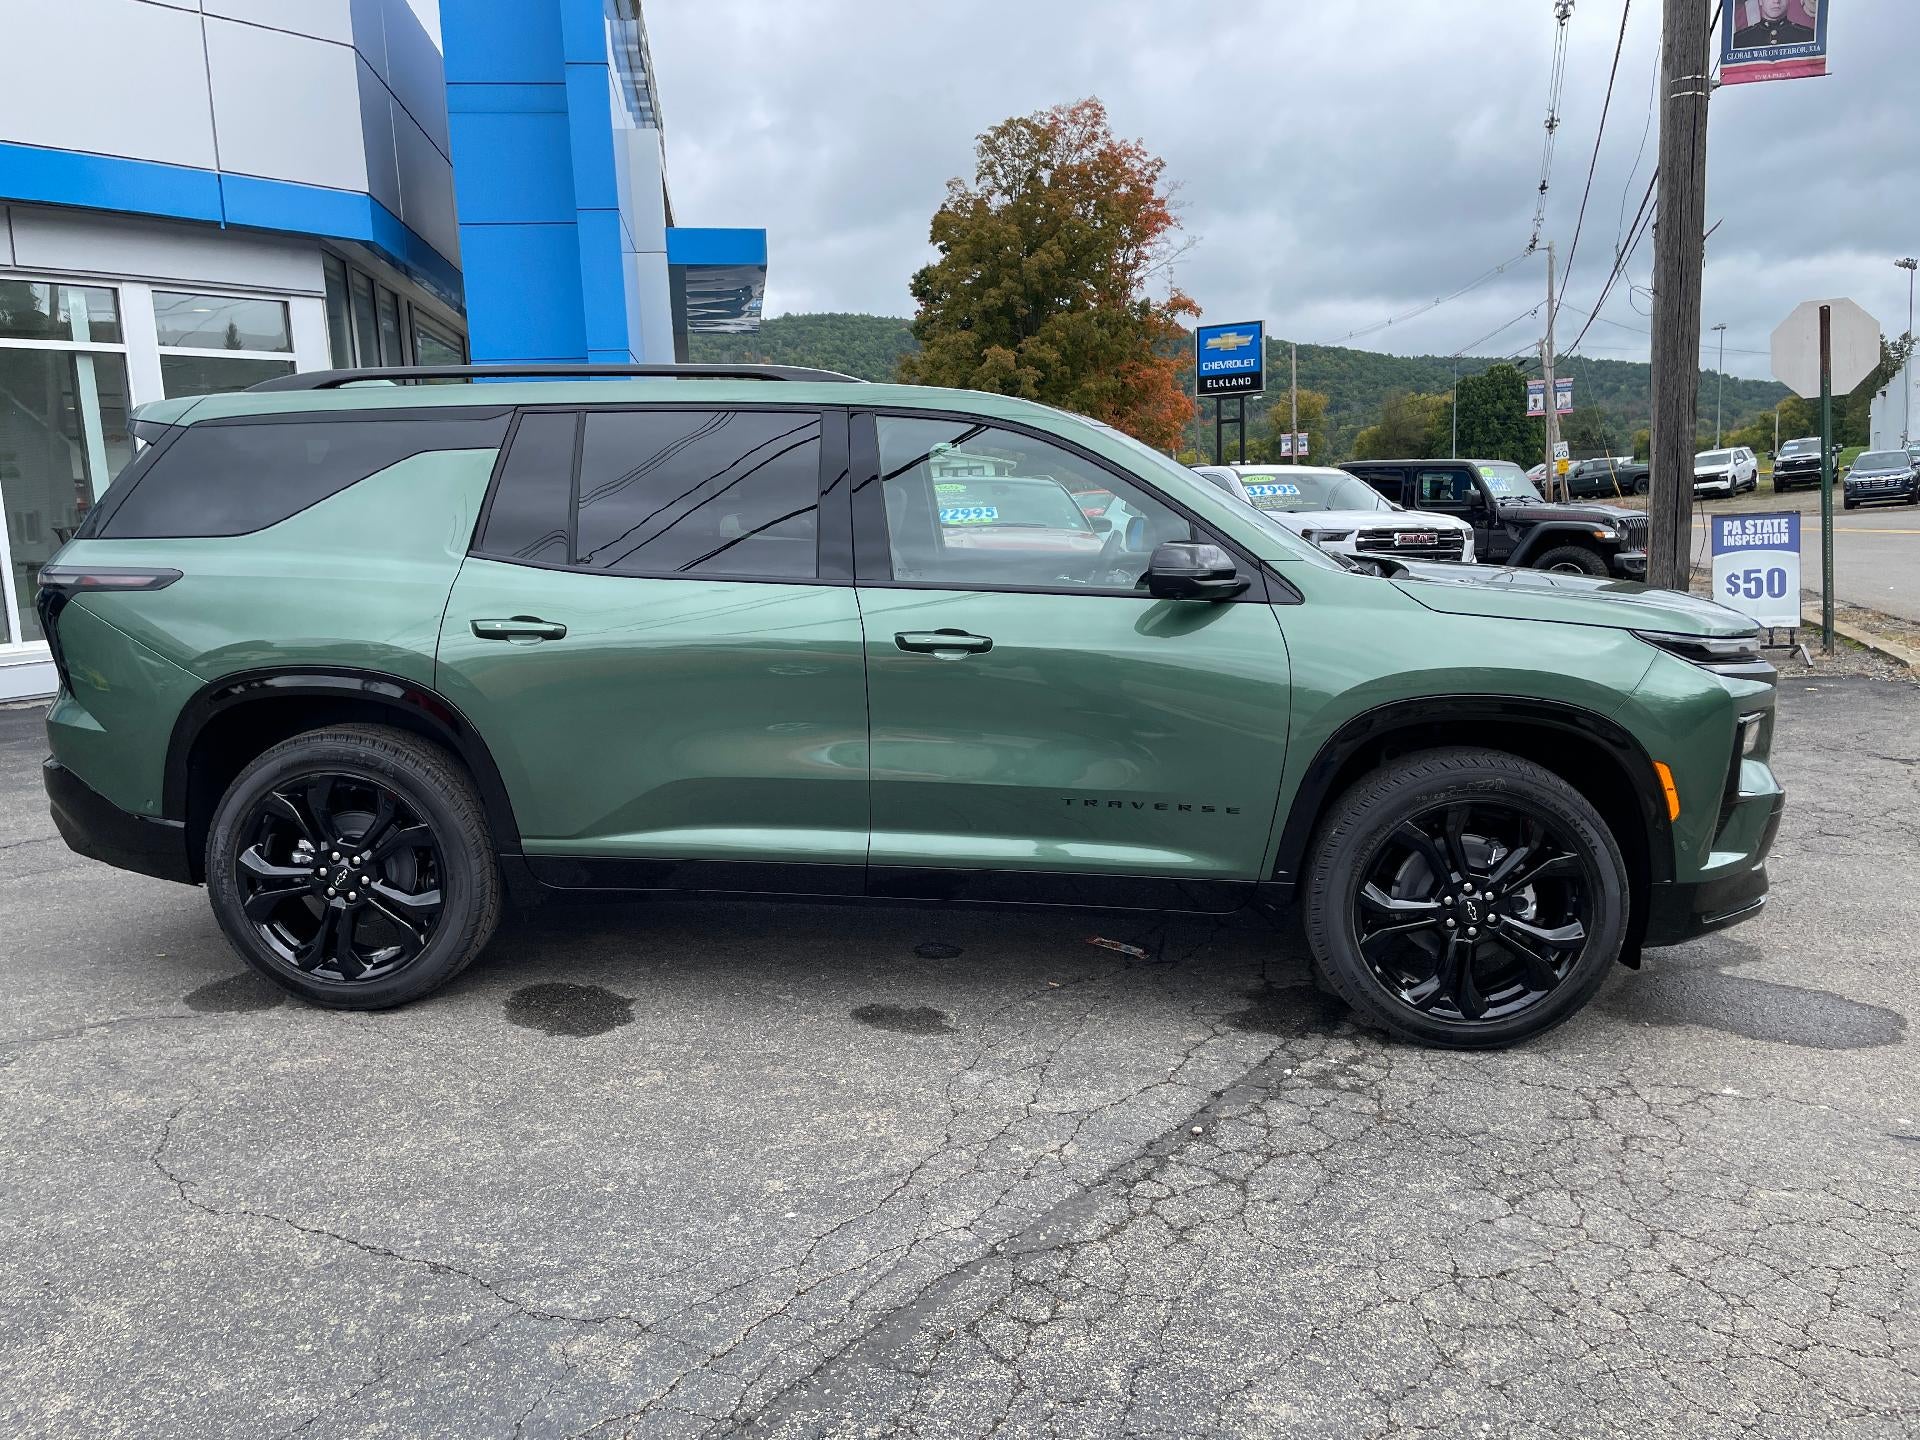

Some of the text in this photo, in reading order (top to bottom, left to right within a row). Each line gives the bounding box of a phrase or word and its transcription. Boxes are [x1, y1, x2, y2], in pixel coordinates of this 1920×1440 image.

[1727, 51, 1752, 60] GLOBAL
[1753, 49, 1768, 58] WAR
[1769, 48, 1779, 57] ON
[1203, 358, 1256, 371] CHEVROLET
[1207, 377, 1251, 388] ELKLAND
[1246, 484, 1298, 496] 32995
[1723, 518, 1789, 535] PA STATE
[1723, 532, 1789, 546] INSPECTION
[1725, 567, 1787, 600] $50
[1061, 797, 1241, 815] TRAVERSE
